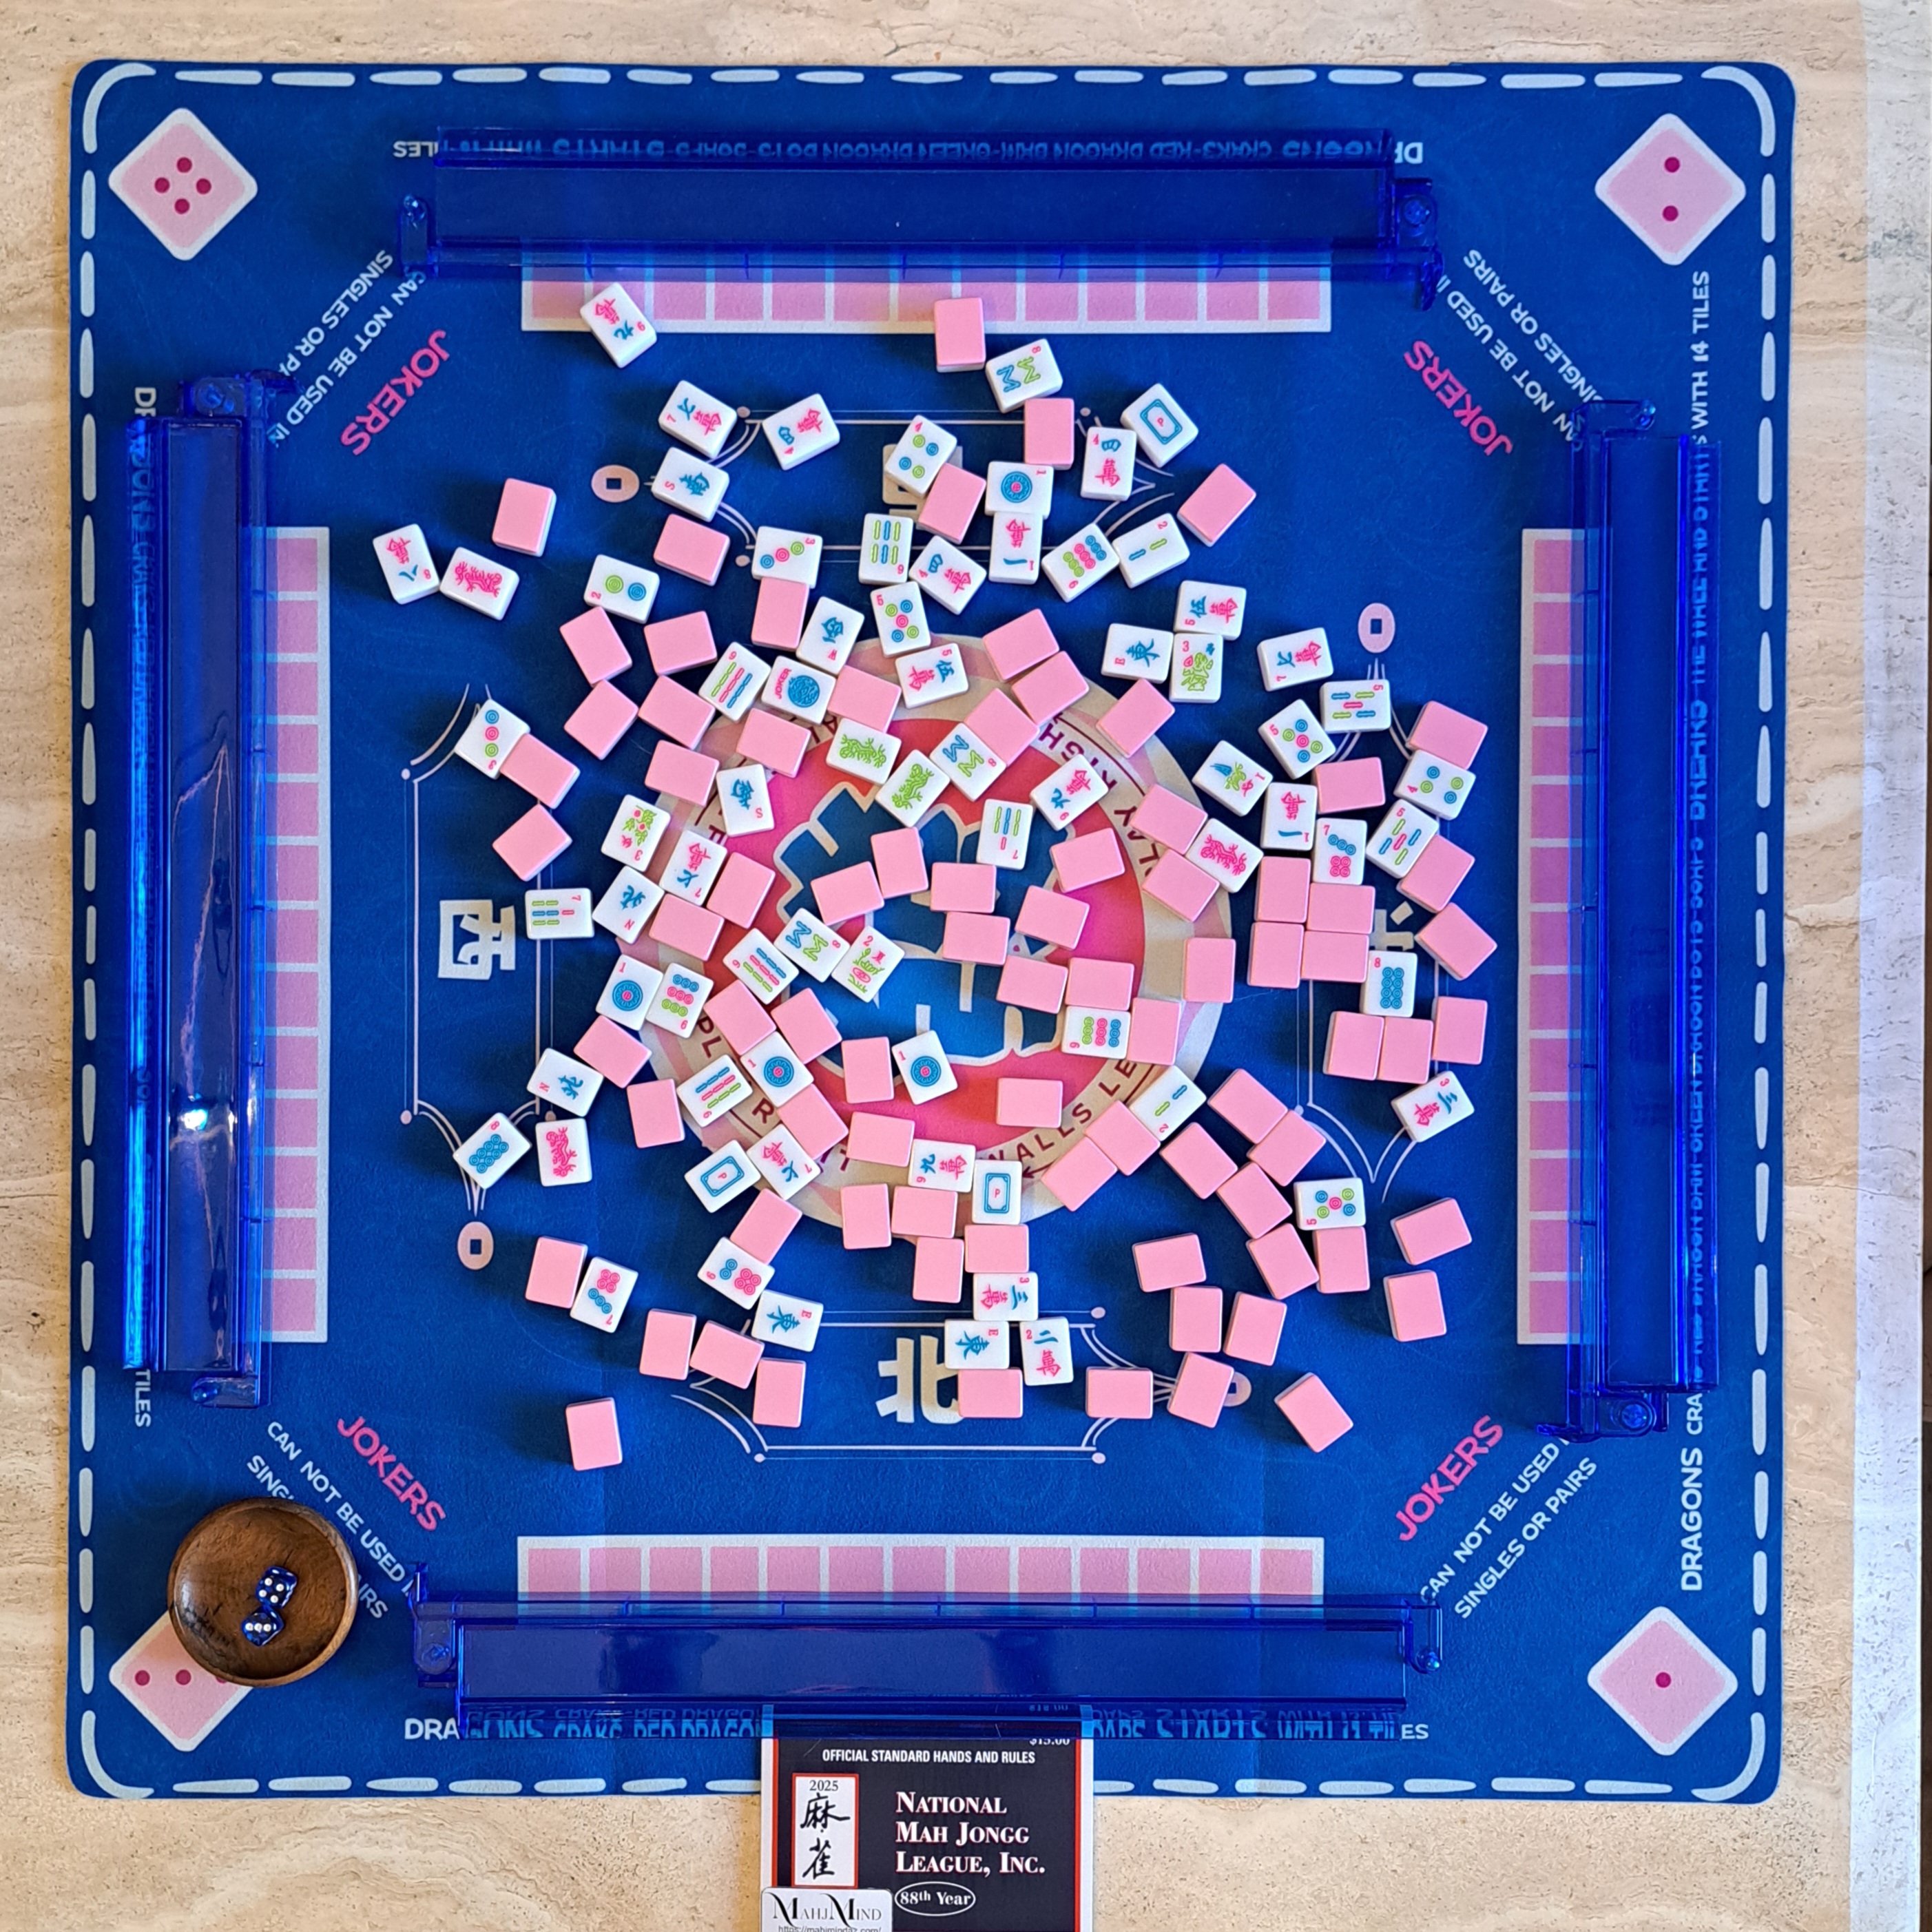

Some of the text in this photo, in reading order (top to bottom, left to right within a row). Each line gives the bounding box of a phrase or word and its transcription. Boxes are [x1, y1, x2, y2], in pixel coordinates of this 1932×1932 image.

[1463, 249, 1515, 308] PAIRS
[294, 249, 393, 357] SINGLES OR
[1692, 271, 1710, 334] TILES
[1510, 302, 1539, 335] OR
[354, 305, 393, 352] NOT
[1031, 346, 1041, 354] 8
[1447, 290, 1555, 413] NOT BE USED
[1690, 340, 1709, 362] 14
[327, 346, 358, 377] BE
[340, 329, 450, 456] JOKERS
[1404, 340, 1513, 456] JOKERS
[287, 374, 334, 425] USED
[1691, 371, 1709, 430] WITH
[664, 481, 675, 490] S
[1157, 521, 1167, 530] 2
[422, 569, 431, 580] 8
[590, 591, 601, 600] 2
[875, 594, 884, 607] 5
[1182, 641, 1190, 653] 3
[827, 650, 837, 661] W
[941, 649, 952, 657] 5
[1114, 657, 1125, 665] E
[774, 668, 790, 699] JOKER
[1269, 724, 1279, 736] 5
[488, 760, 497, 770] 3
[988, 758, 997, 767] 8
[755, 807, 762, 818] S
[1396, 807, 1404, 818] 5
[1323, 824, 1330, 835] 7
[634, 849, 643, 861] 3
[1011, 849, 1019, 860] 7
[624, 920, 634, 930] N
[831, 939, 840, 948] 8
[862, 935, 873, 947] 2
[619, 962, 625, 973] 1
[1373, 957, 1381, 968] 8
[898, 1050, 906, 1061] 1
[747, 1059, 756, 1068] 1
[539, 1082, 549, 1092] N
[1439, 1078, 1450, 1088] 3
[490, 1121, 499, 1131] 8
[1159, 1123, 1169, 1133] 2
[1305, 1218, 1317, 1226] 5
[800, 1310, 811, 1319] E
[1025, 1329, 1032, 1340] 2
[135, 1368, 152, 1427] TILES
[247, 1455, 295, 1499] SING
[337, 1415, 446, 1531] JOKERS
[1395, 1415, 1503, 1541] JOKERS
[267, 1421, 405, 1582] CAN NOT BE USED
[1420, 1442, 1559, 1604] CAN NOT BE USED
[1681, 1447, 1703, 1591] DRAGONS
[1454, 1457, 1597, 1619] SINGLES OR PAIRS
[822, 1749, 1035, 1764] OFFICIAL STANDARD HANDS AND RULES
[809, 1780, 839, 1791] 2025
[900, 1890, 970, 1907] 88th Year
